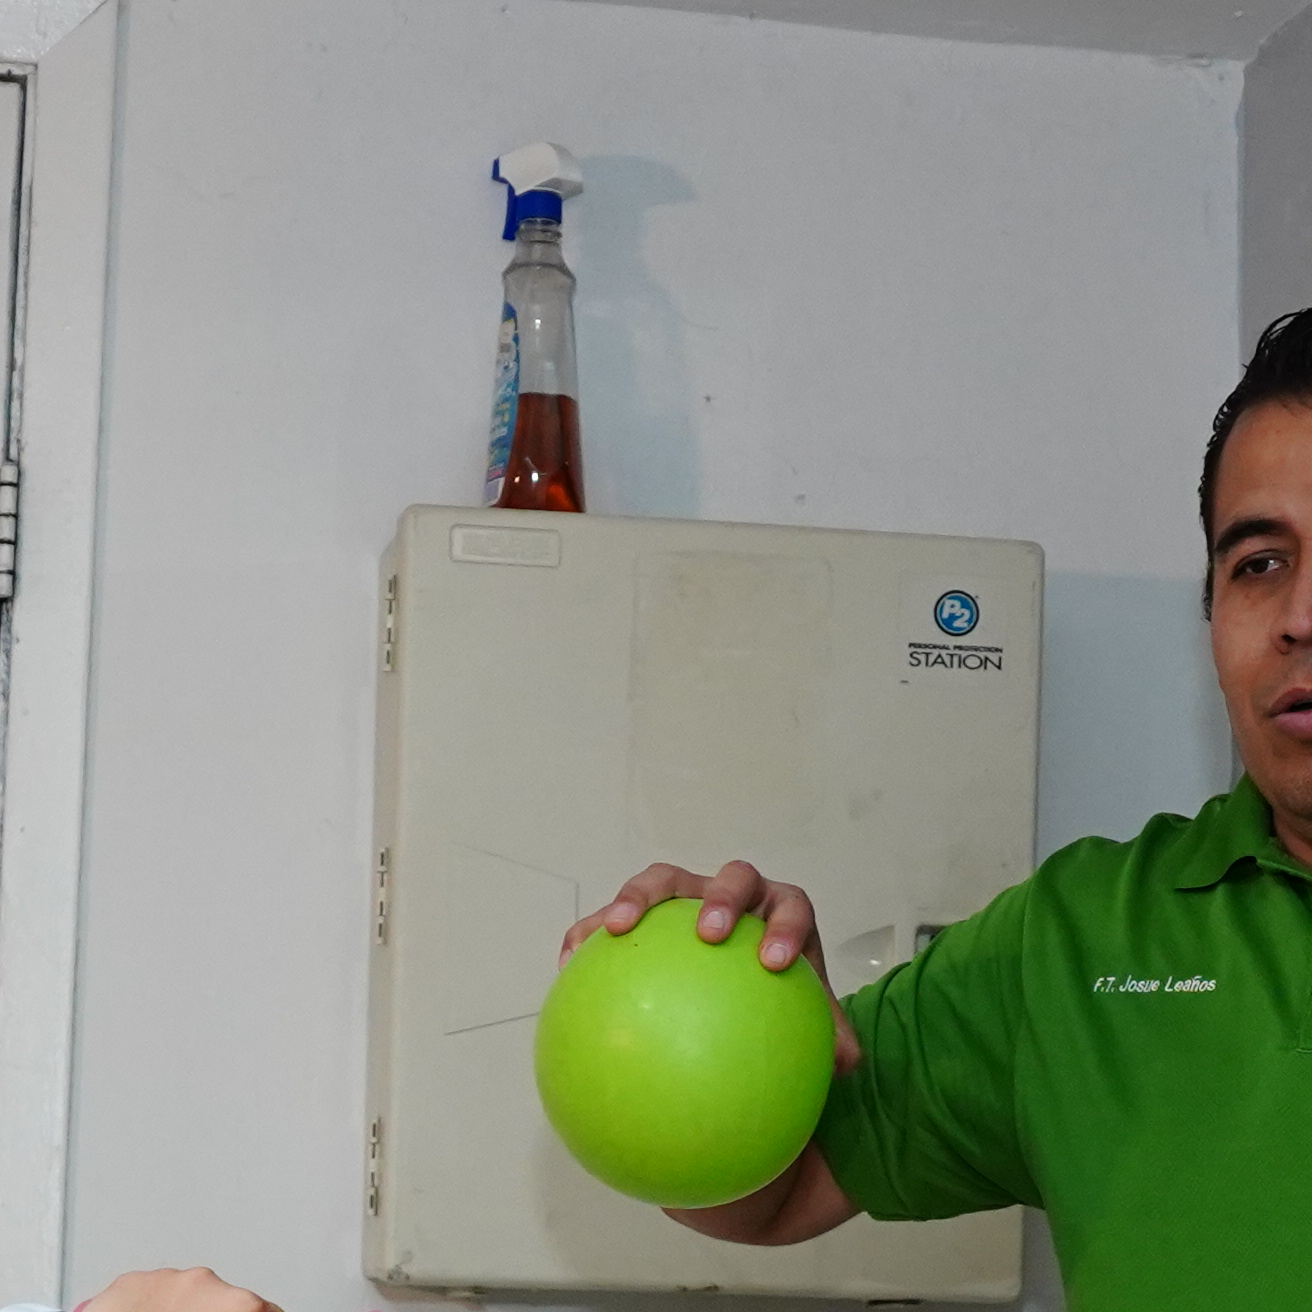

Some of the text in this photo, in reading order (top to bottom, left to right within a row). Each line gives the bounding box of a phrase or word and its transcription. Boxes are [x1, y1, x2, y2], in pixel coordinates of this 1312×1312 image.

[909, 651, 1002, 670] STATION
[1093, 974, 1217, 993] F.T. Josue Leaños
